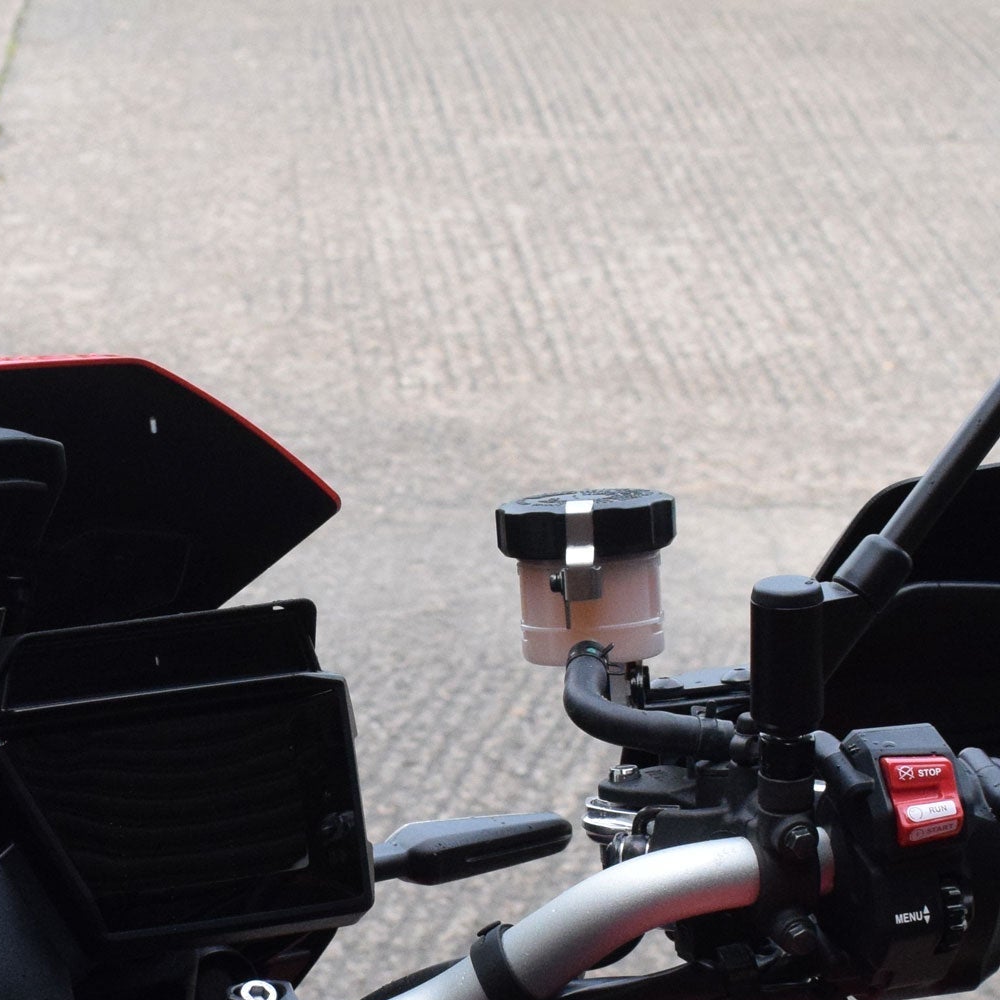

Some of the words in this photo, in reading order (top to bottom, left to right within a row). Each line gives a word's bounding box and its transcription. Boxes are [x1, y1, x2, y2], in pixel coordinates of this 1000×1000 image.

[917, 767, 942, 778] STOP
[928, 804, 949, 815] RUN
[926, 822, 955, 835] START
[894, 911, 924, 925] MENU
